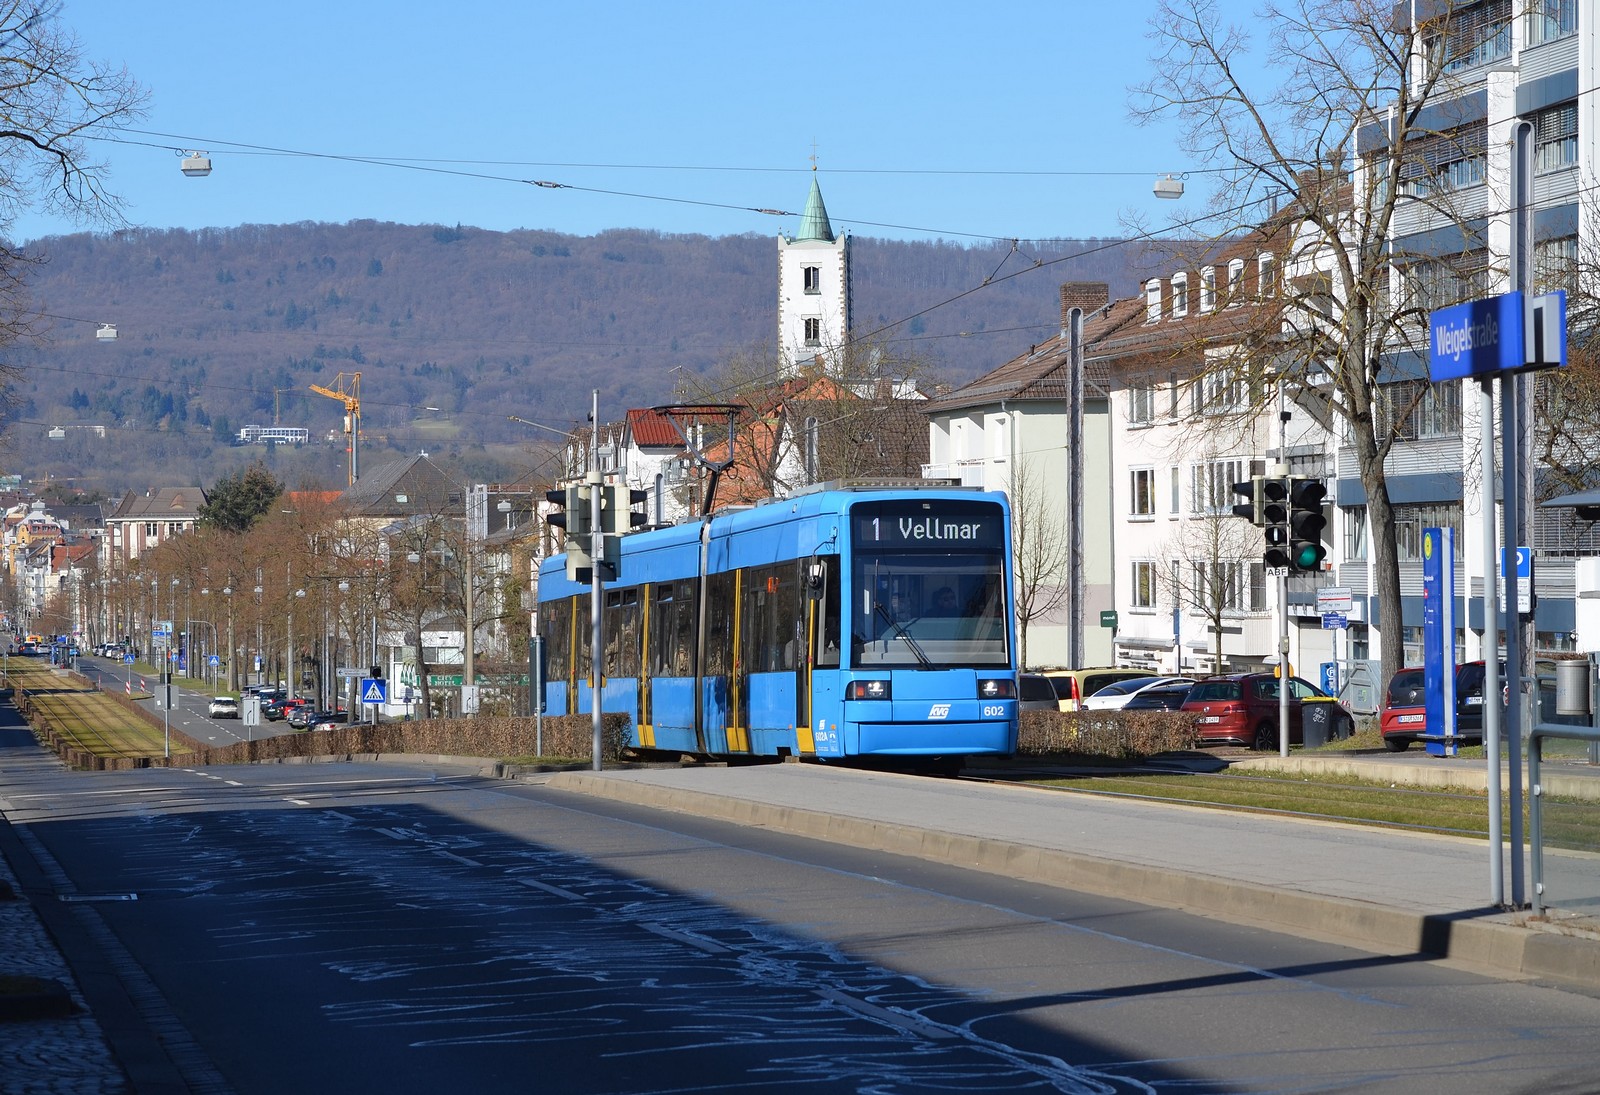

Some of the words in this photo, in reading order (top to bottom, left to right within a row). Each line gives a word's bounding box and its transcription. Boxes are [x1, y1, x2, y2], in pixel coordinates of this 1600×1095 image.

[1435, 312, 1498, 362] Weigelstraße
[872, 517, 881, 541] 1
[899, 517, 981, 539] Vellmar
[1267, 568, 1287, 576] ABF
[928, 704, 951, 718] KVG
[984, 706, 1004, 717] 602
